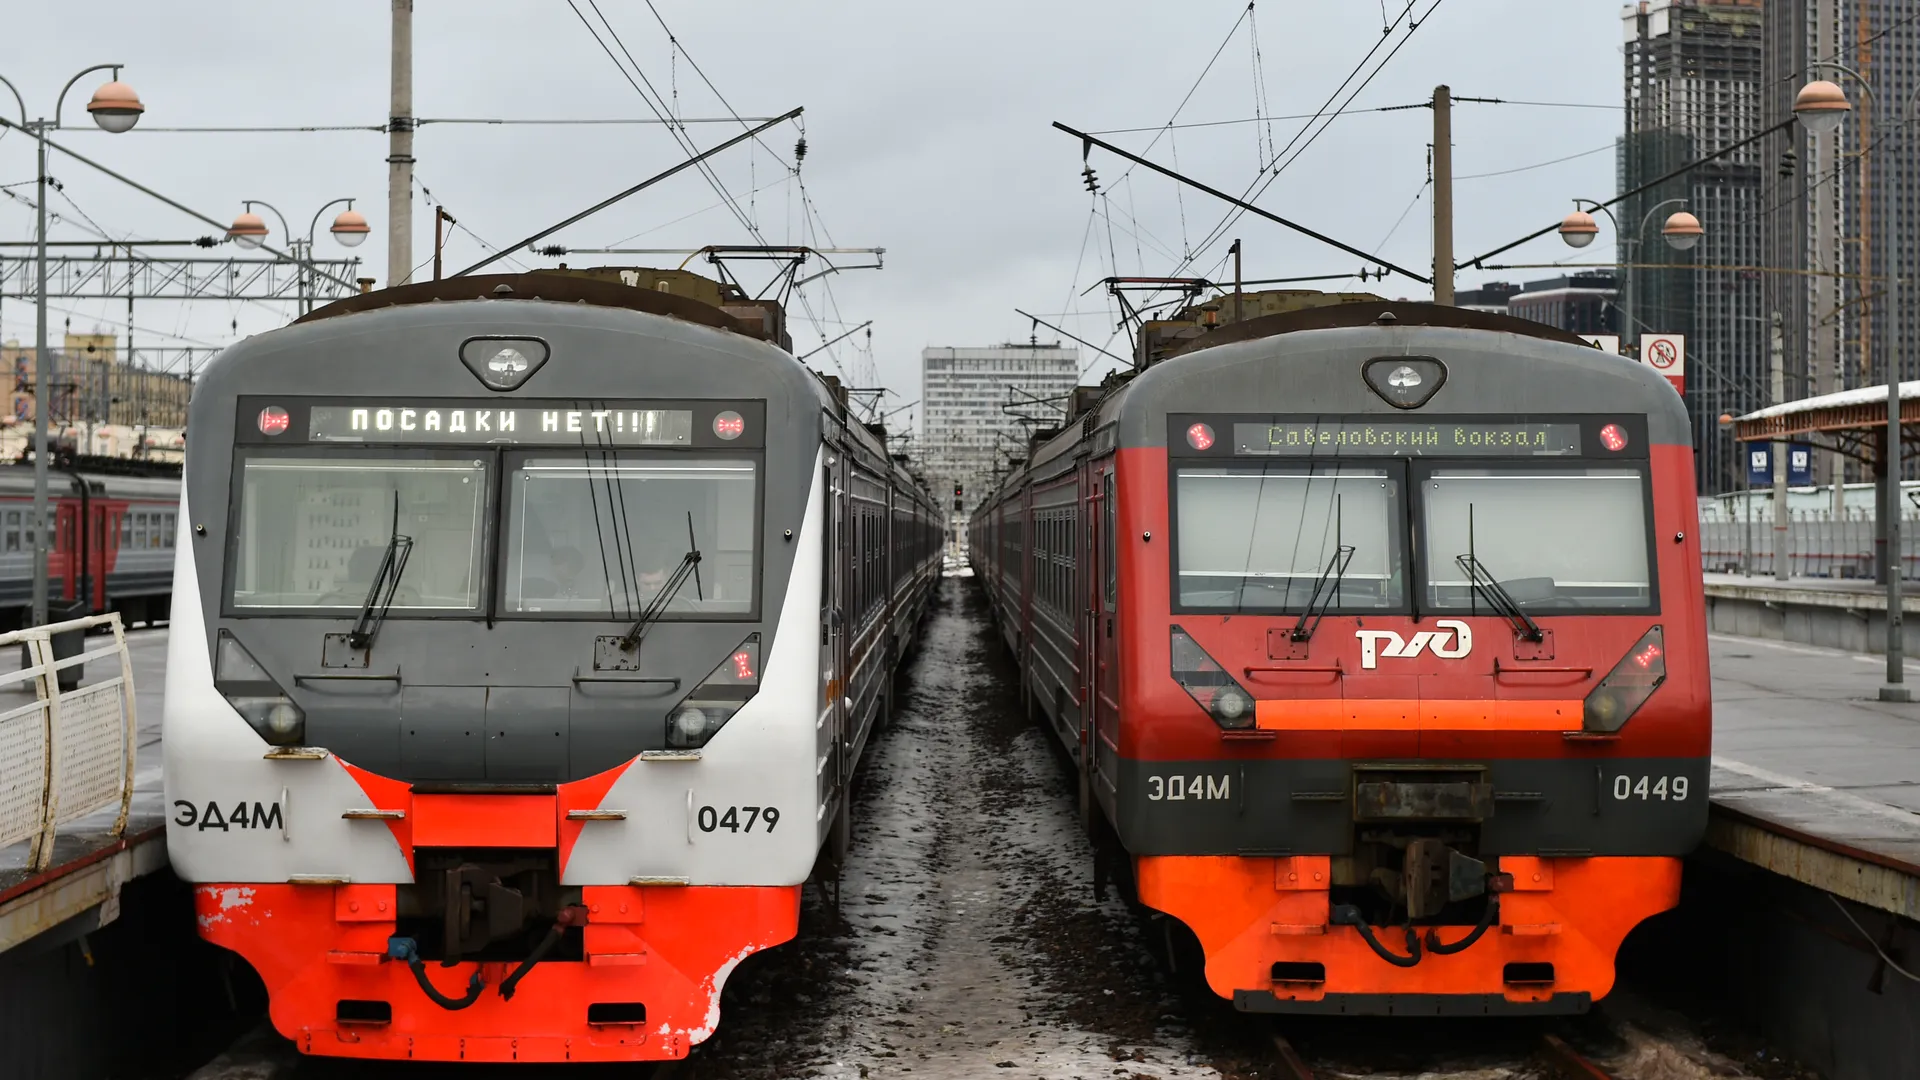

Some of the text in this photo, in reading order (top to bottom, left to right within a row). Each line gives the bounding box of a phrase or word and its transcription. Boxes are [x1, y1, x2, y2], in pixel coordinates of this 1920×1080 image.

[351, 408, 654, 433] ПОСАДКИ НЕТ!!!
[1267, 426, 1547, 446] Савеловский вокзал
[1147, 774, 1230, 801] ЭД4М
[1613, 774, 1689, 802] 0449
[173, 799, 284, 832] ЭД4М
[697, 805, 780, 834] 0479
